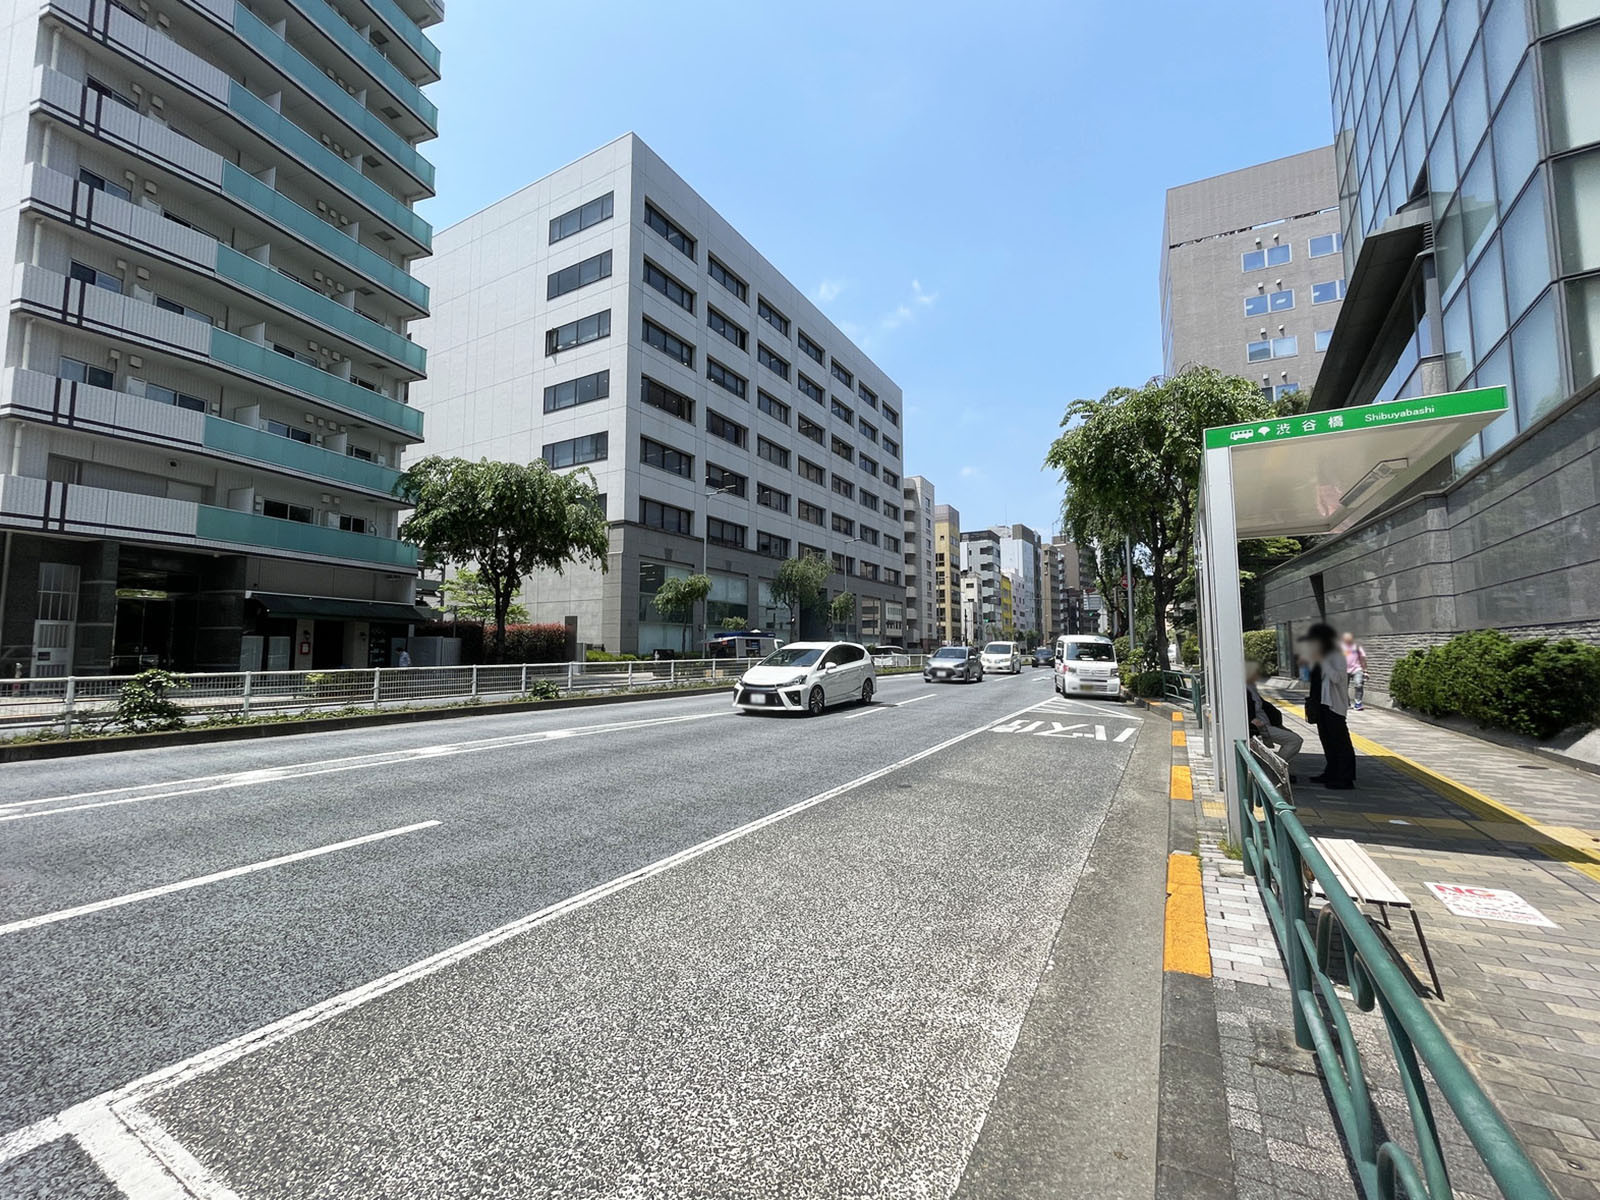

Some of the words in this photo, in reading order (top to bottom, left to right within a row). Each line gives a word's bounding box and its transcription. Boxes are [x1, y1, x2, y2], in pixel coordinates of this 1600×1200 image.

[1365, 406, 1435, 422] Shibuyabashi
[1276, 415, 1344, 435] 渋谷橋
